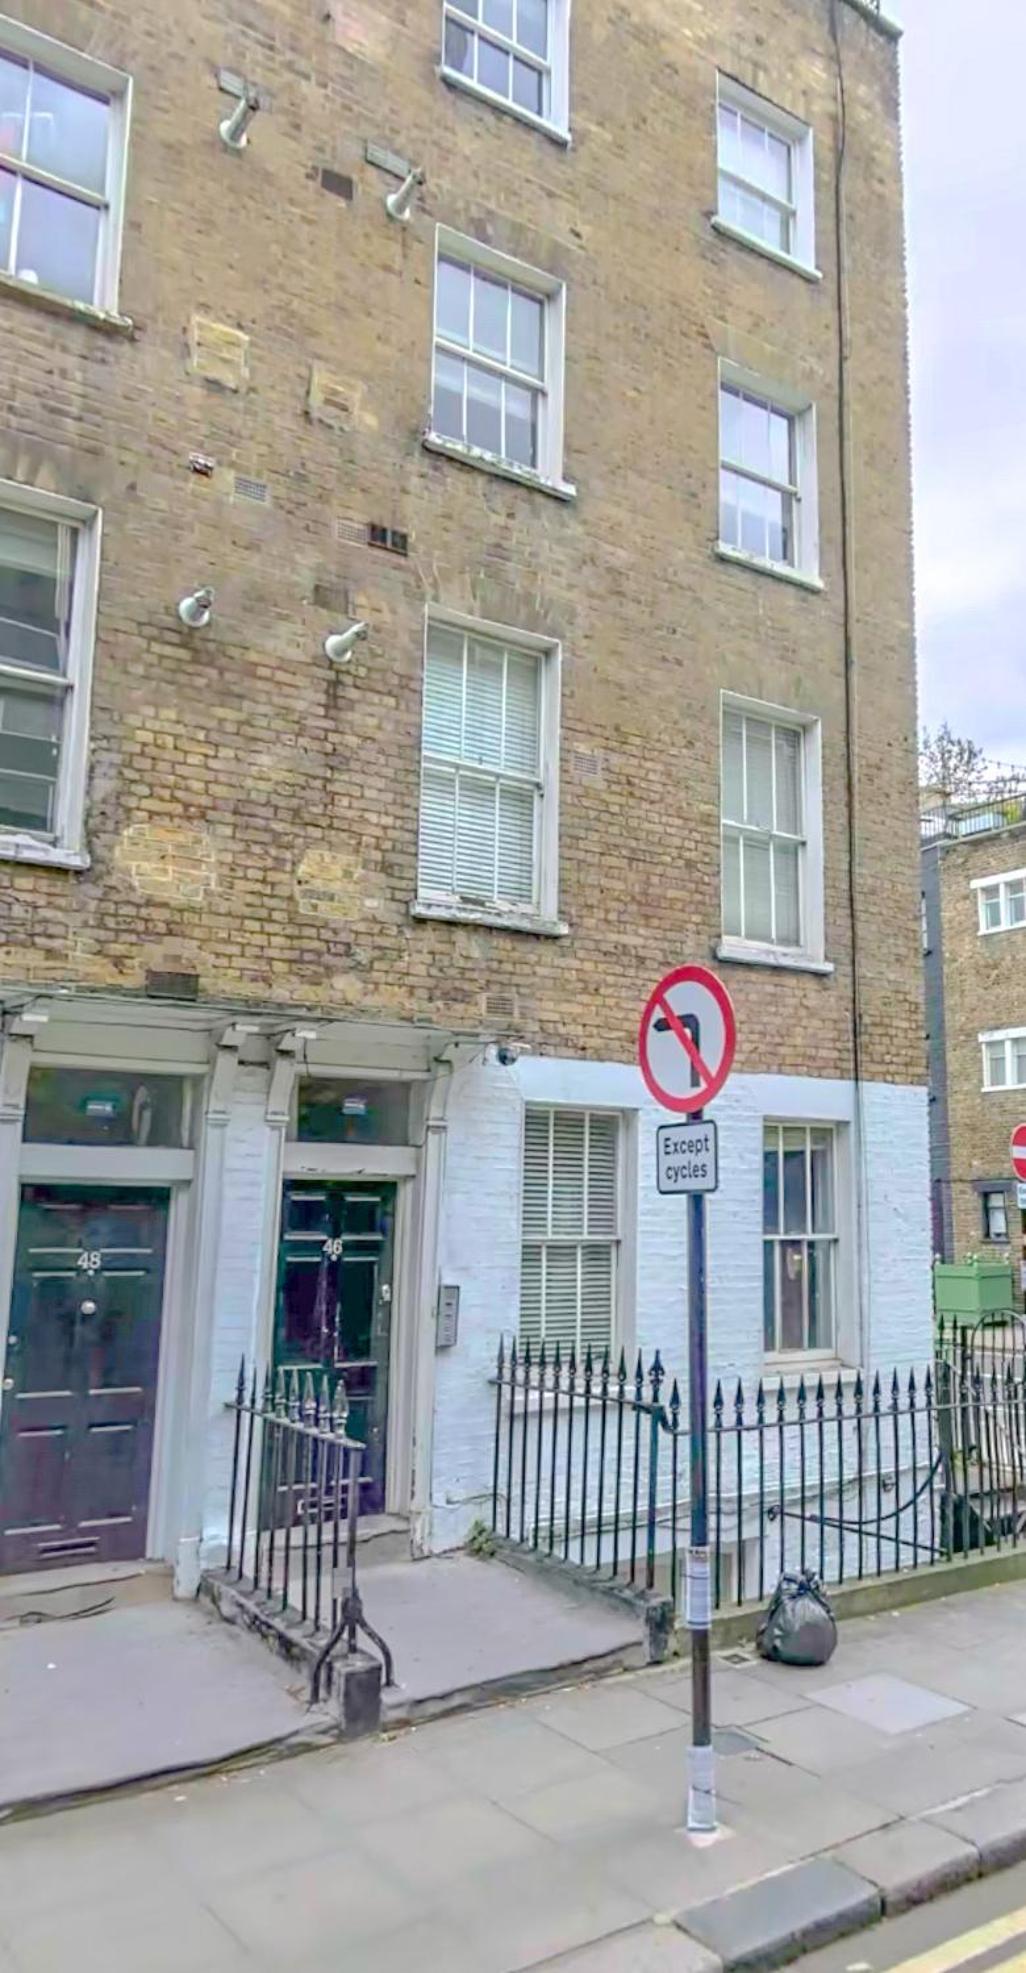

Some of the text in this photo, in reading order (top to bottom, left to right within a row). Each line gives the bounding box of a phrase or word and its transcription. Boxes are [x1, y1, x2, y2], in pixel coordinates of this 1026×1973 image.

[663, 1135, 710, 1156] Except
[665, 1160, 708, 1183] cycles
[322, 1239, 343, 1255] 46
[77, 1251, 101, 1269] 48
